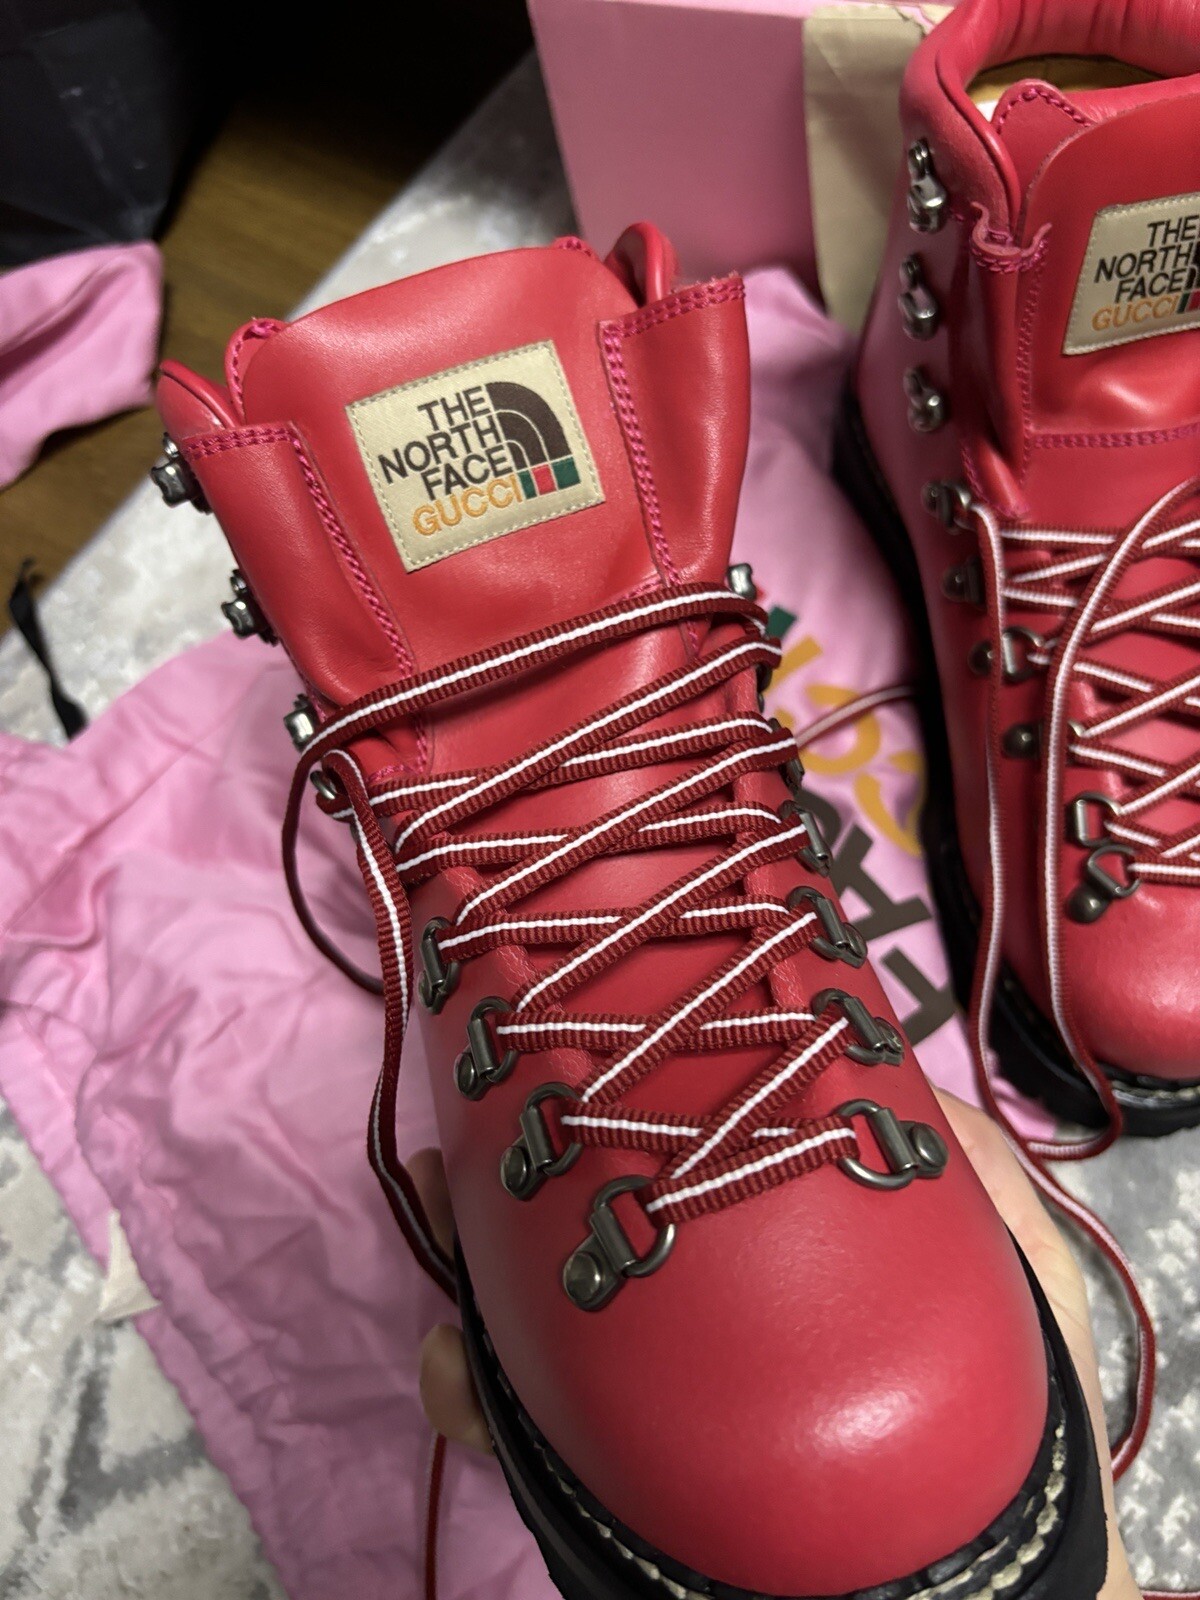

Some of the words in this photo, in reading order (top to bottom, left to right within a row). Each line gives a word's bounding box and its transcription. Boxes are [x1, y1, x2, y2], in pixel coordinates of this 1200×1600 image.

[1147, 215, 1200, 247] THE
[1094, 242, 1194, 283] NORTH
[1114, 268, 1187, 303] FACE
[1091, 294, 1179, 331] GUCCI
[417, 386, 491, 431] THE
[377, 415, 501, 484] NORTH
[420, 445, 513, 501] FACE
[412, 474, 523, 537] GUCCI
